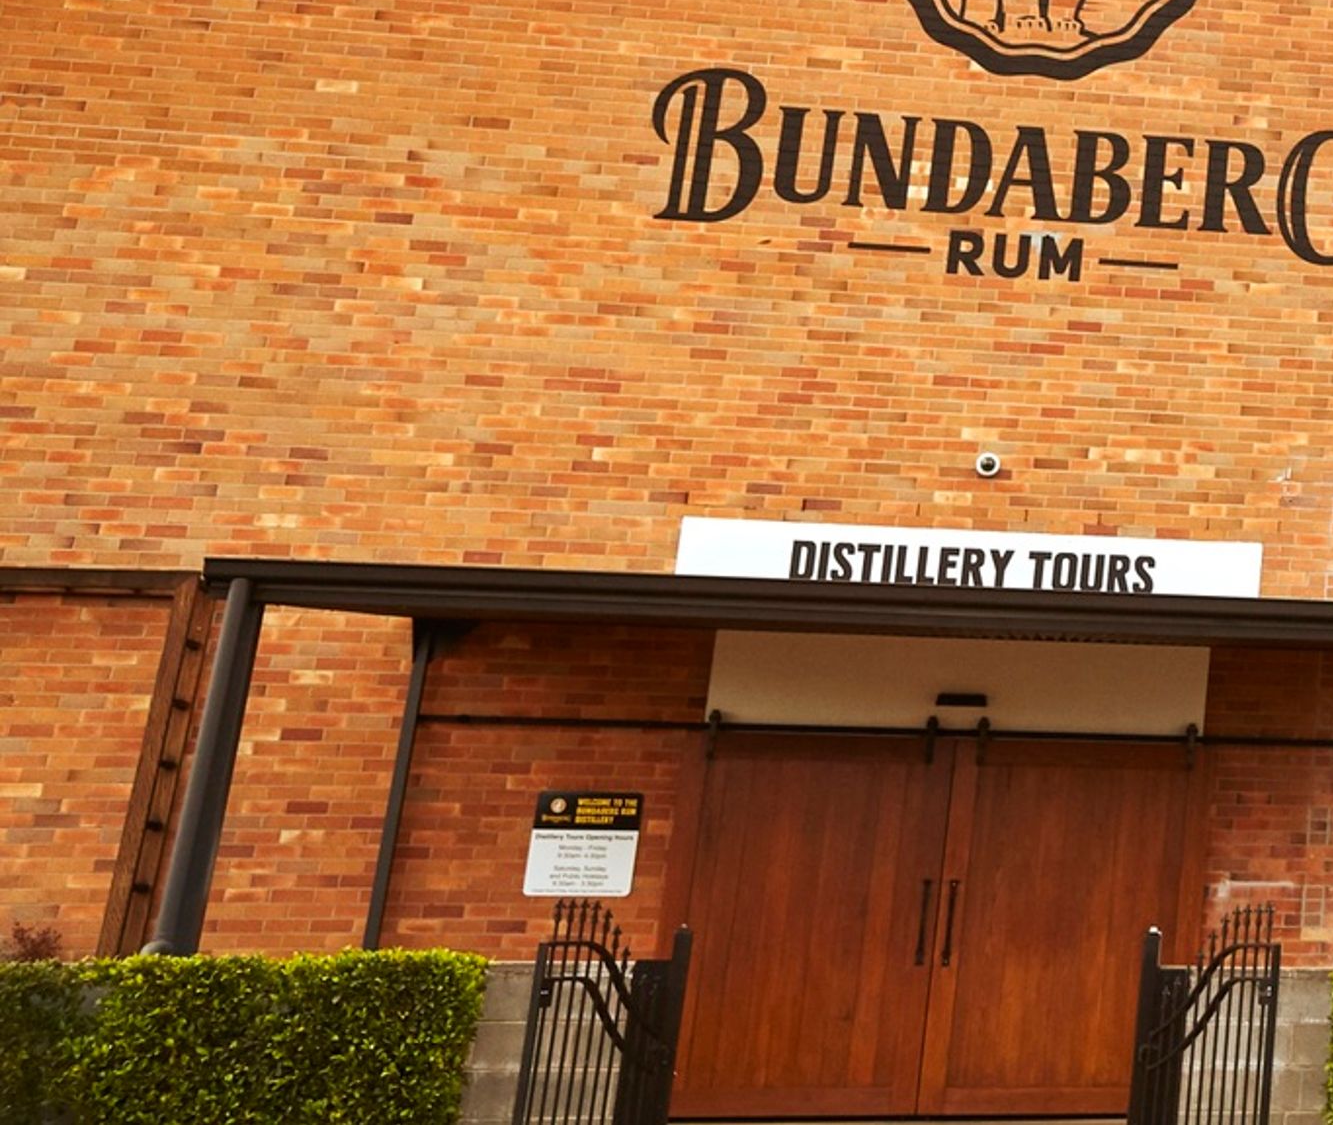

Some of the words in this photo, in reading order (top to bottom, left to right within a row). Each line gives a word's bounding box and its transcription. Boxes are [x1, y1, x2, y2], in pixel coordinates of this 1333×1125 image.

[945, 229, 1084, 283] RUM
[789, 540, 1014, 587] DISTILLERY
[1029, 551, 1156, 593] TOURS
